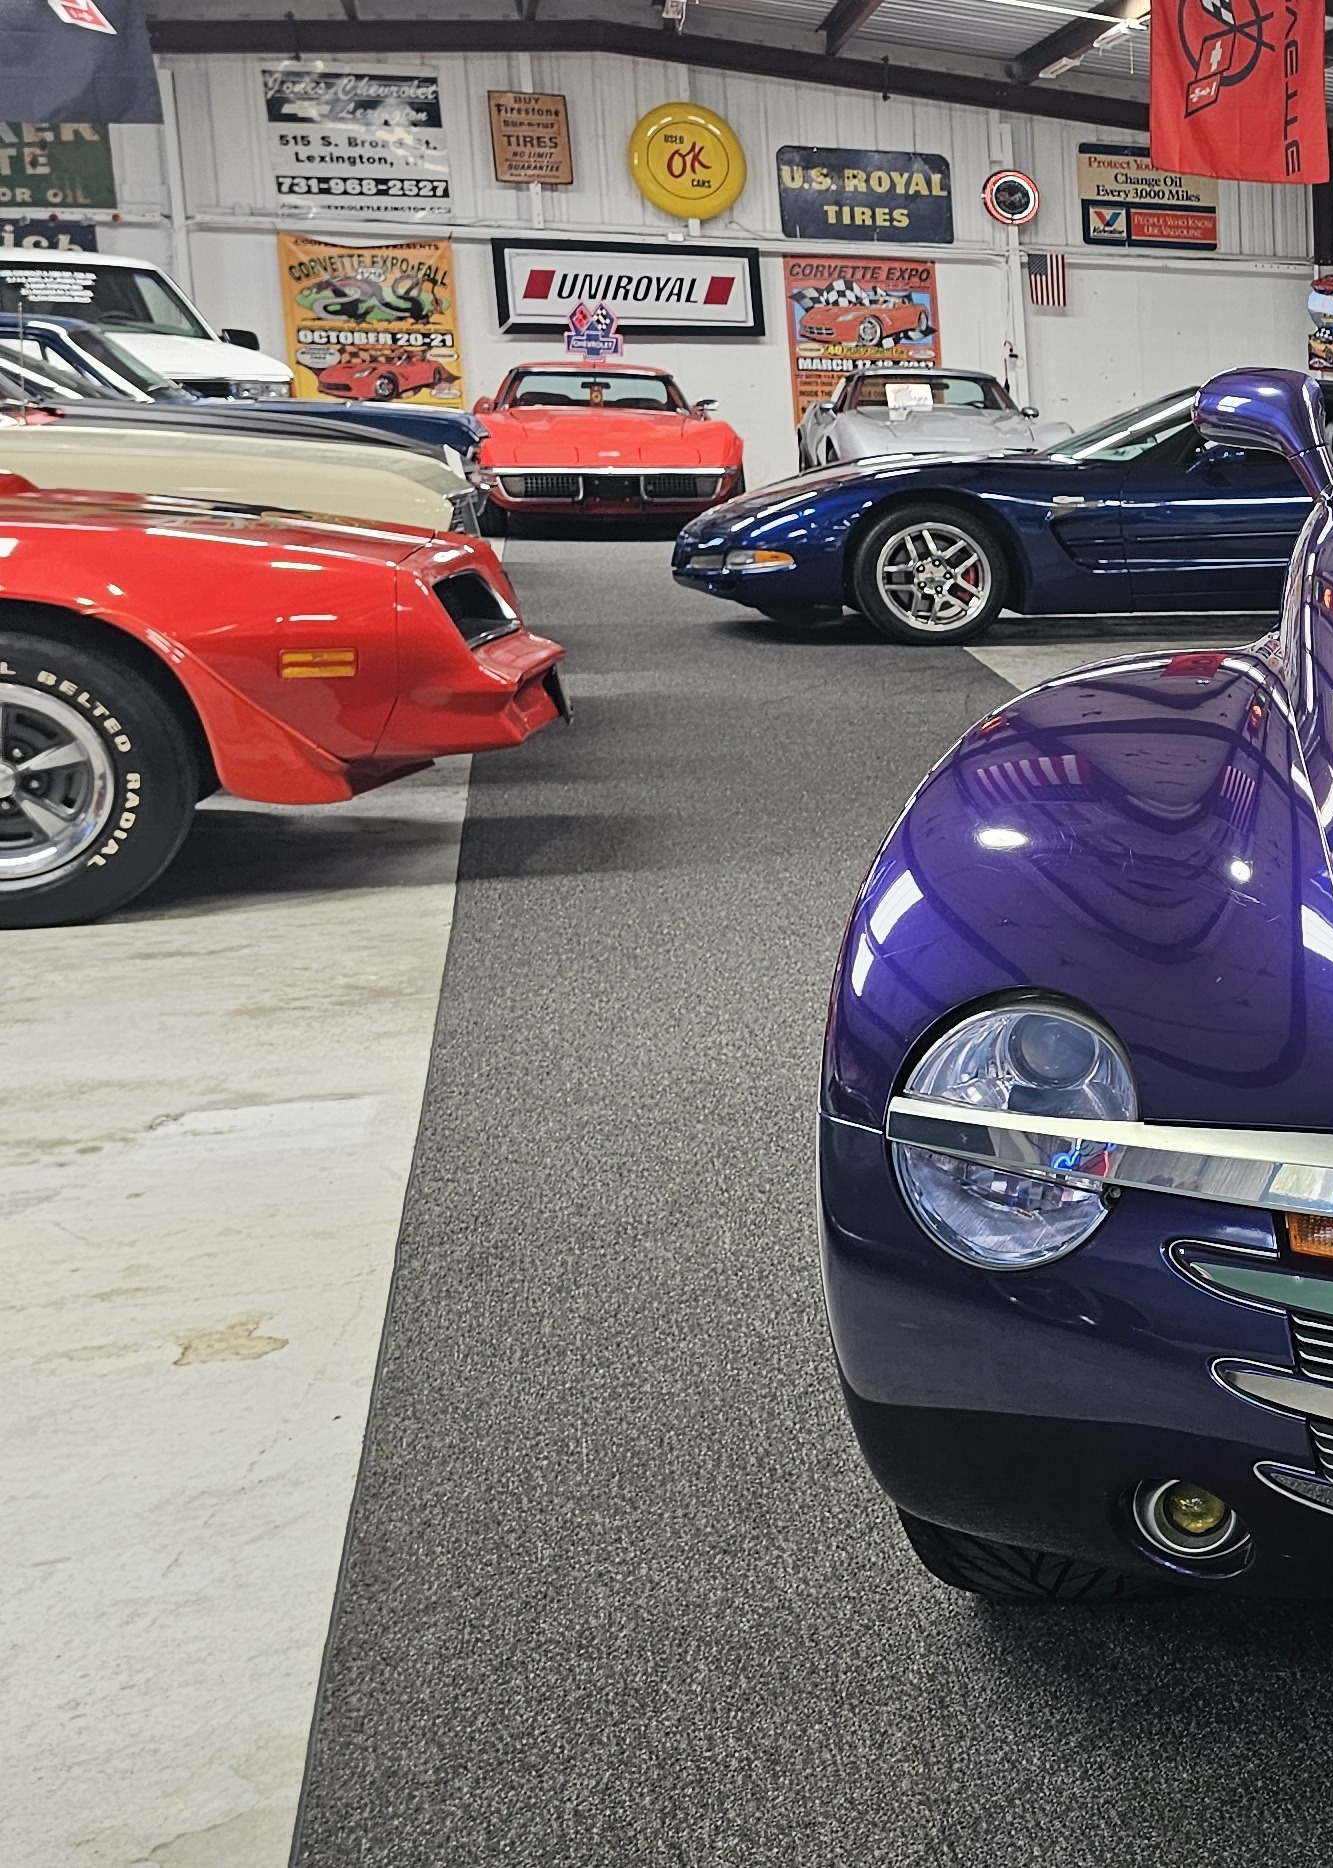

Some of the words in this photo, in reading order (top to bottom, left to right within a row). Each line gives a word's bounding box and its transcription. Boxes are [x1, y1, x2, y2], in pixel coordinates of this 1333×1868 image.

[332, 75, 440, 101] Chevrolet
[513, 95, 540, 104] BUY
[494, 102, 560, 117] Firestone
[278, 134, 312, 147] 515
[321, 135, 339, 148] S.
[502, 134, 558, 149] TIRES
[664, 134, 685, 145] USED
[294, 151, 395, 168] Lexington,
[528, 151, 554, 160] LIMIT
[667, 141, 712, 179] OK
[1088, 156, 1131, 171] Protect
[278, 177, 448, 197] 731-968-2527
[691, 178, 712, 189] CARS
[781, 165, 837, 191] U.S.
[844, 168, 948, 197] ROYAL
[1114, 172, 1162, 188] Change
[1163, 175, 1183, 188] Oil
[1096, 184, 1130, 201] Every
[1167, 189, 1201, 202] Miles
[823, 205, 910, 228] TIRES
[288, 253, 366, 282] CORVETTE
[370, 255, 410, 274] EXPO
[416, 261, 449, 287] FALL
[789, 262, 882, 280] CORVETTE
[885, 268, 932, 283] EXPO
[557, 273, 698, 303] UNIROYAL
[298, 329, 393, 345] OCTOBER
[396, 333, 453, 347] 20-21
[572, 340, 614, 349] CHEVROLET
[798, 358, 854, 371] MARCH
[36, 670, 132, 752] BELTED
[86, 772, 142, 867] RADIAL
